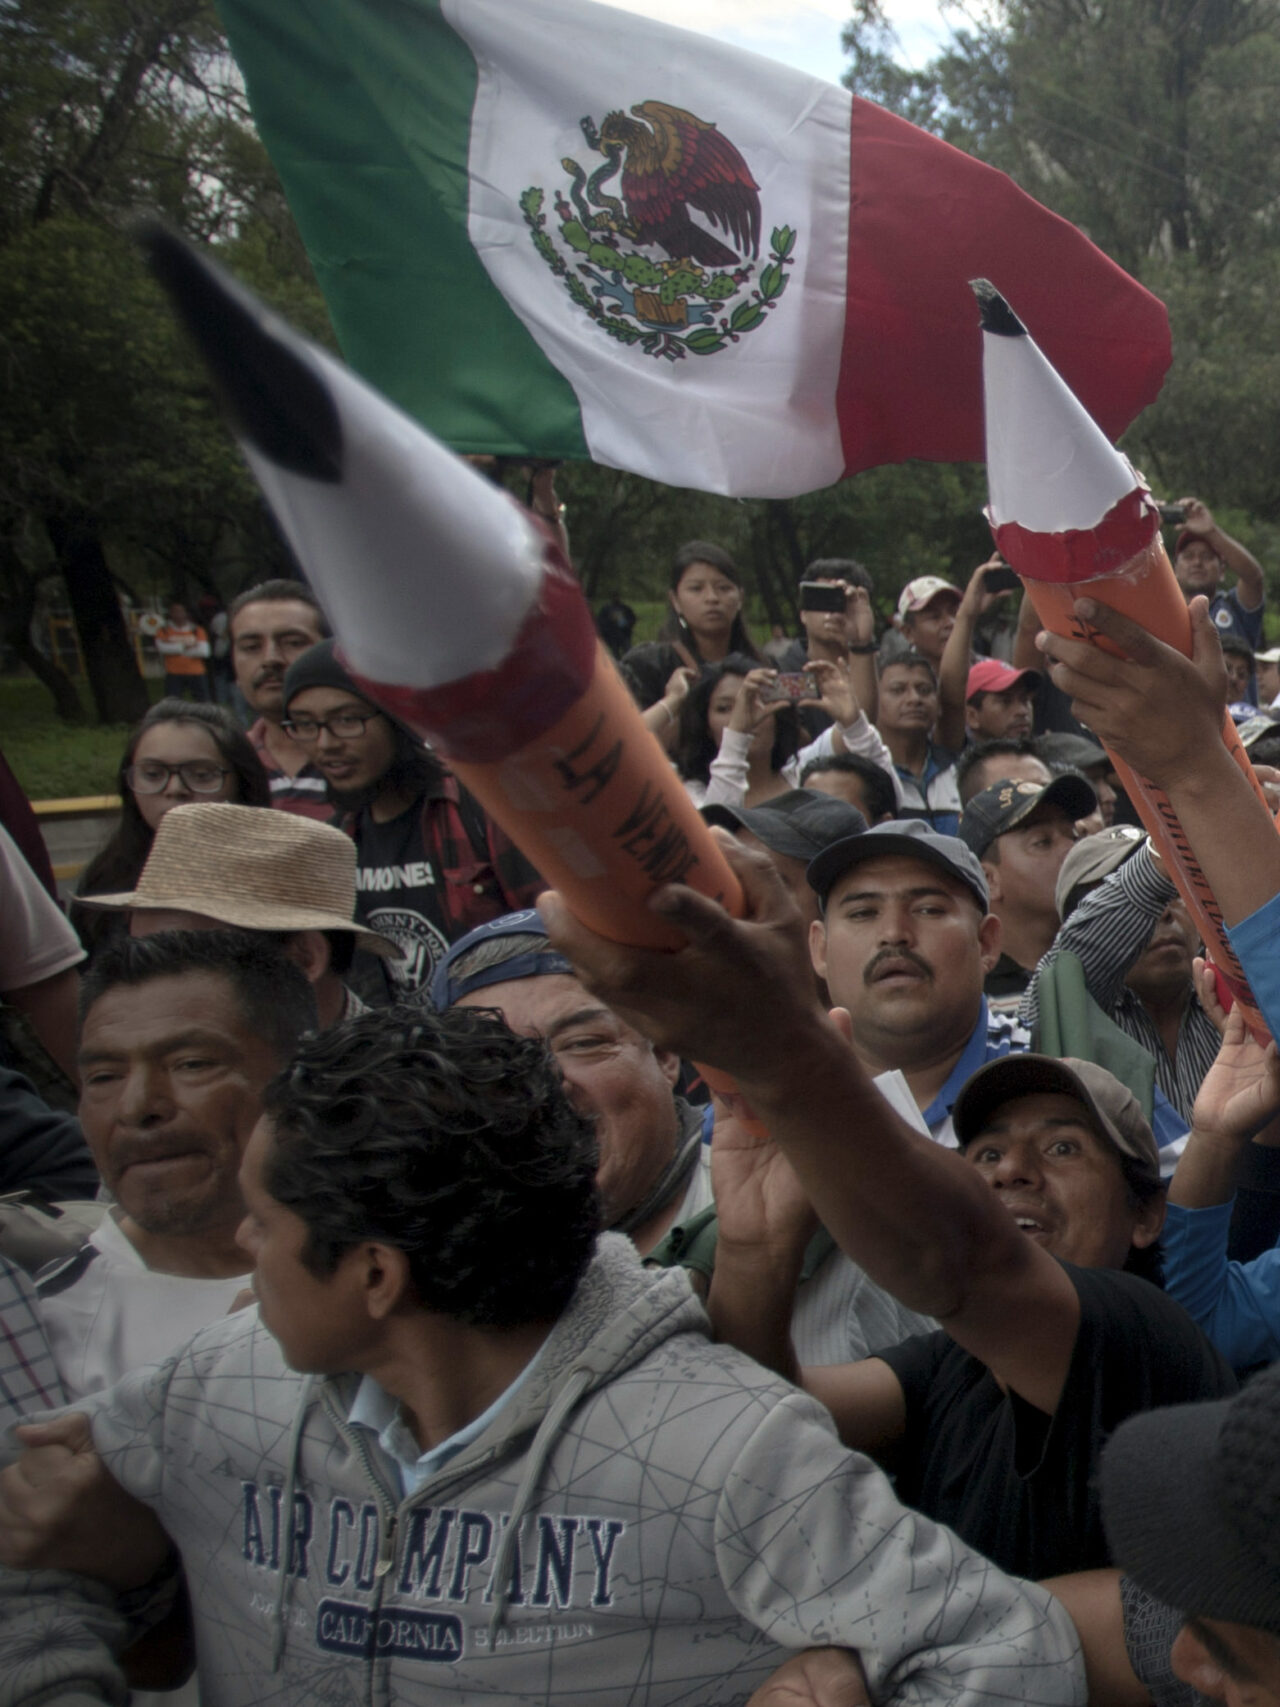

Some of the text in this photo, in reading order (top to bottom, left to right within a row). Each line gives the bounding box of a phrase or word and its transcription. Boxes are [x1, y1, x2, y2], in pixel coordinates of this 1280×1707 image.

[553, 708, 624, 805] LA
[241, 1479, 628, 1610] AIR COMPANY
